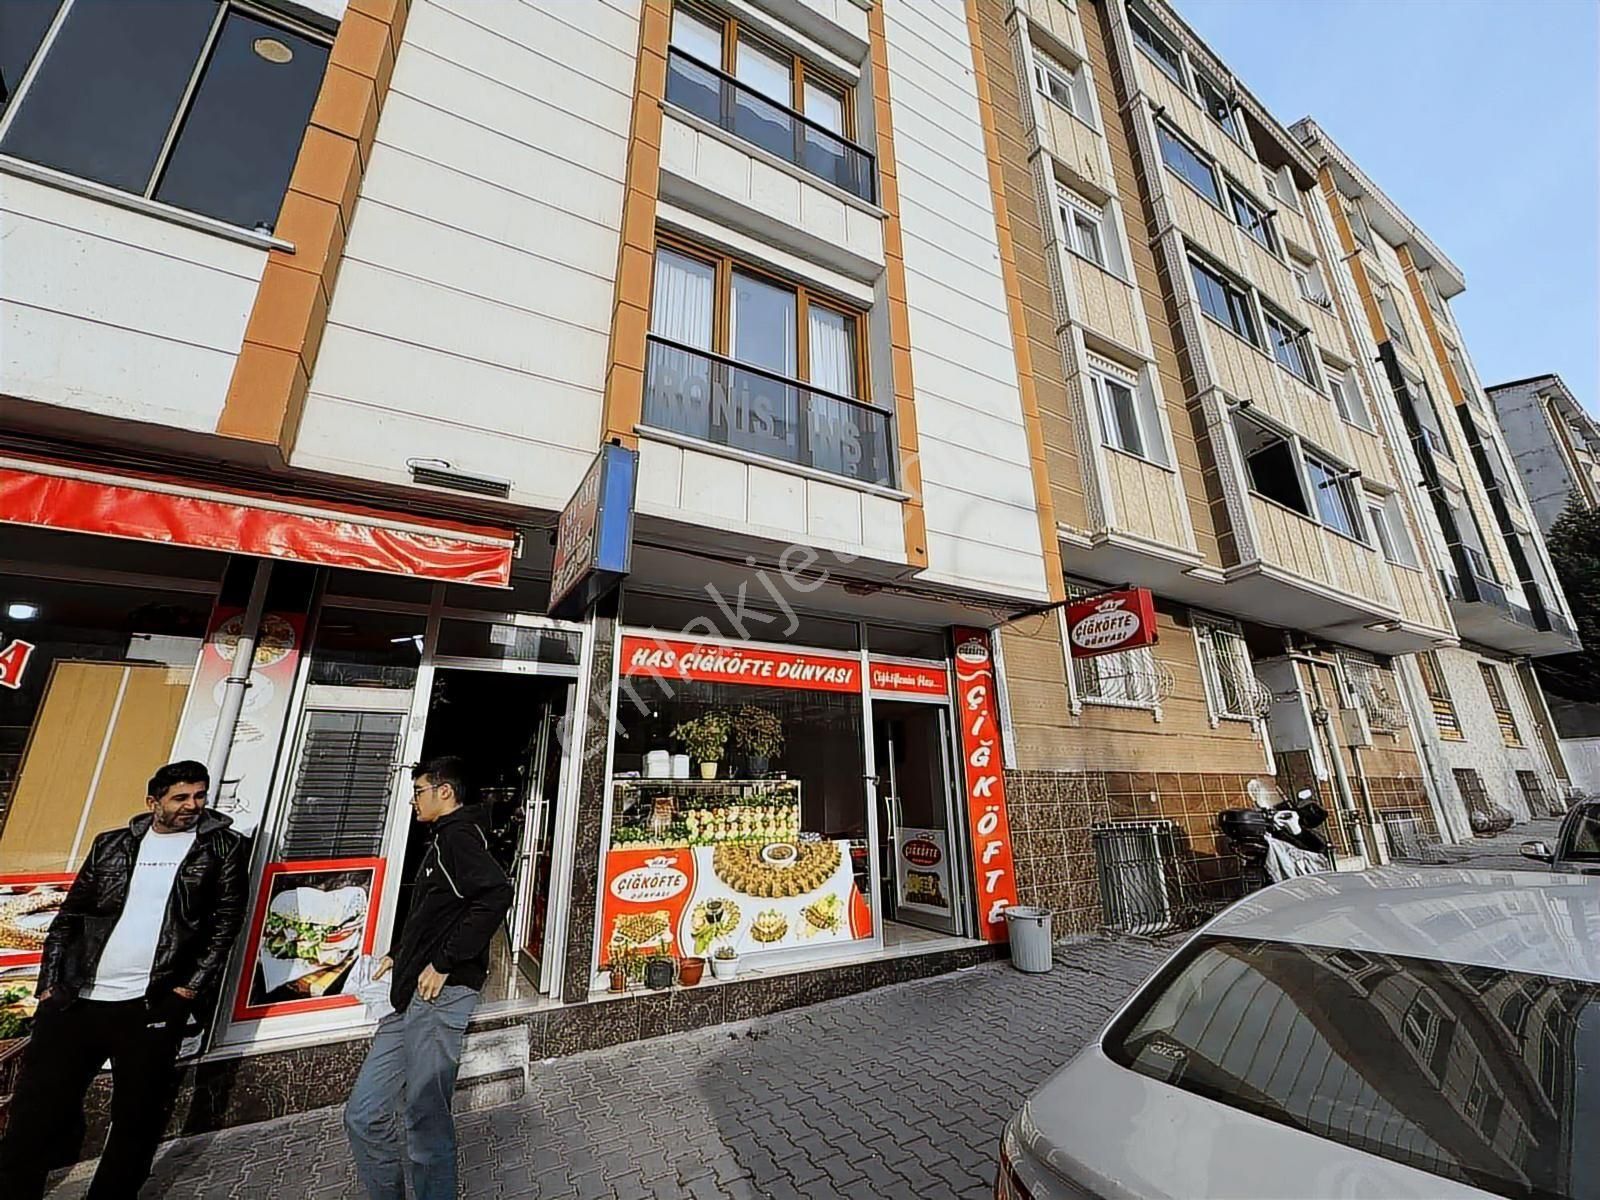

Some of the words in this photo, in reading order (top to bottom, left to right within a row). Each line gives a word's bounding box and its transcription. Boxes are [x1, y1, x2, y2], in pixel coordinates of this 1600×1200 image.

[1075, 614, 1132, 641] ÇİĞKÖFTE
[631, 647, 676, 668] HAS
[678, 648, 771, 679] ÇİĞKÖFTE
[776, 660, 853, 684] DÜNYASI
[966, 684, 1010, 925] ÇİĞKÖFTE
[617, 872, 682, 894] ÇİĞKÖFTE
